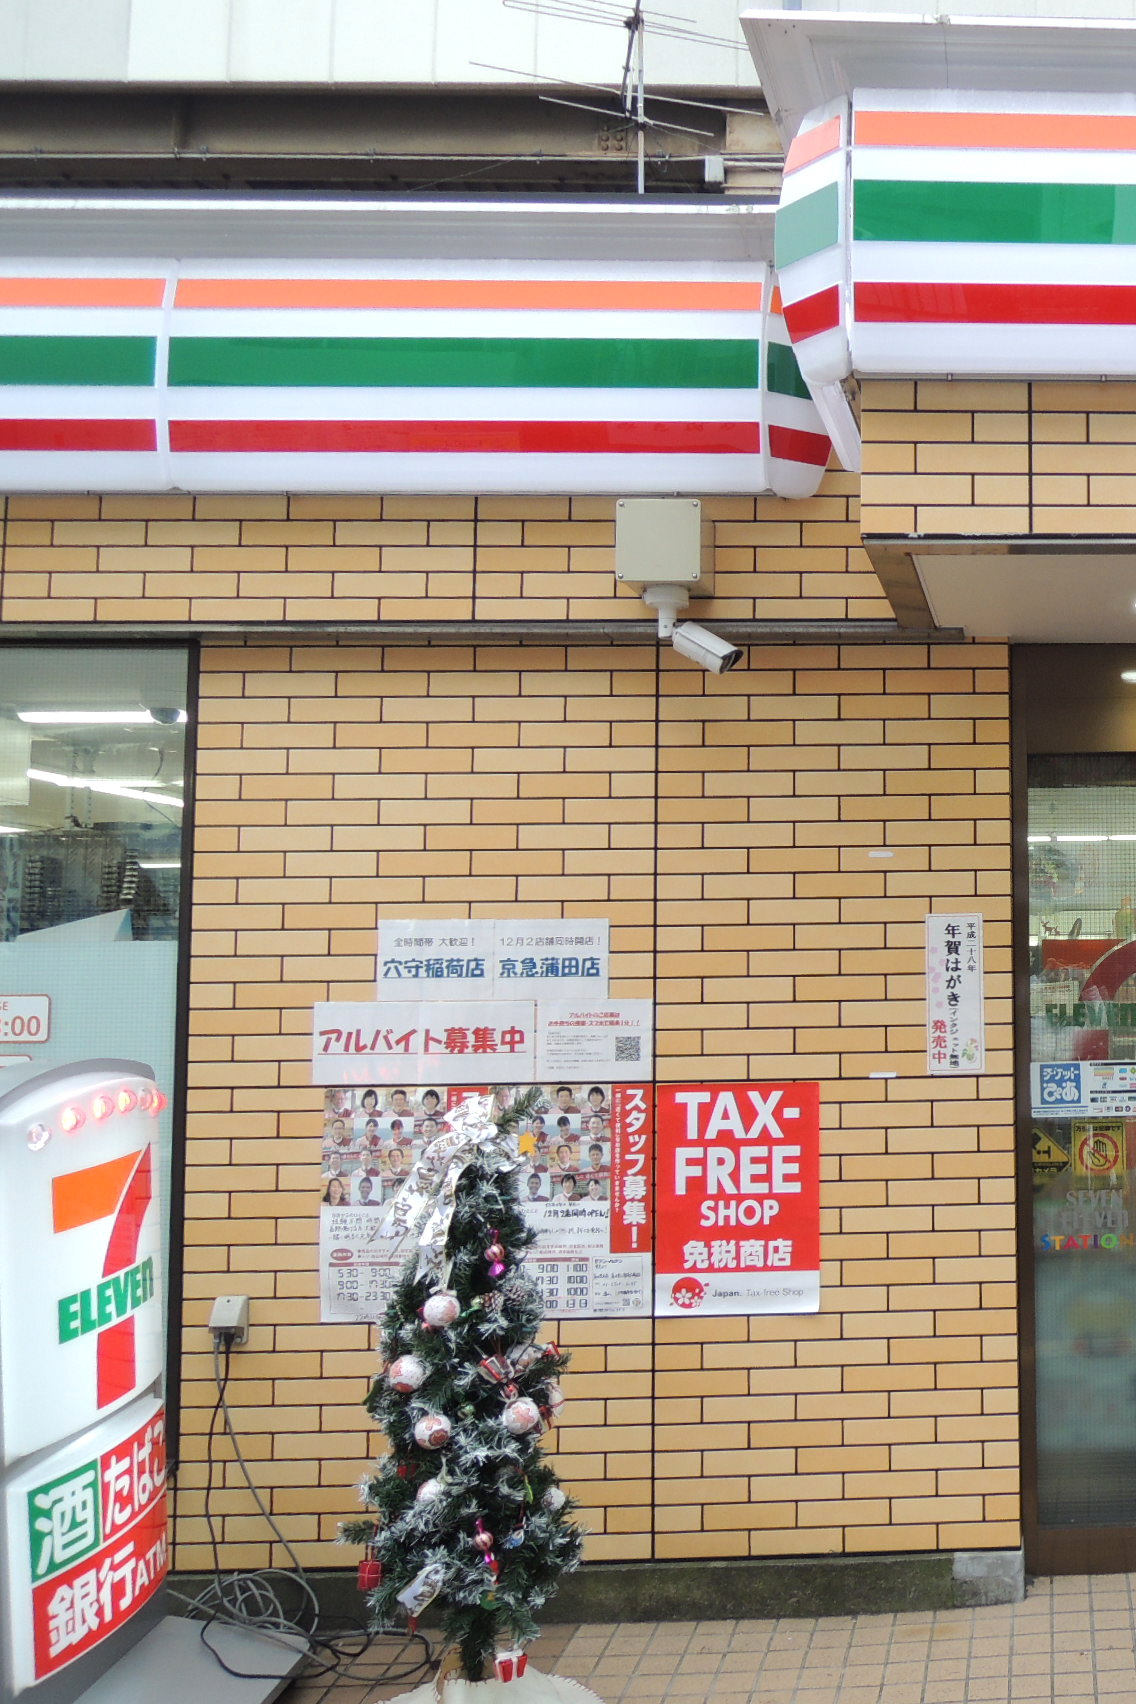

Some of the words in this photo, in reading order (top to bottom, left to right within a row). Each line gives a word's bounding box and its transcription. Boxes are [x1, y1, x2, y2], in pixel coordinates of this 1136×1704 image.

[966, 922, 977, 973] 平成二十八年
[383, 957, 486, 978] 穴守稲荷店
[499, 956, 601, 977] 京急蒲田店
[944, 923, 962, 1007] 年賀はがき
[0, 1015, 42, 1037] :00
[318, 1024, 526, 1053] アルバイト募集中
[931, 1019, 948, 1065] 発売中
[1043, 1067, 1080, 1080] チケット
[1043, 1081, 1080, 1102] ぴあ
[674, 1090, 801, 1140] TAX-
[622, 1088, 648, 1249] スタッフ募集!
[674, 1145, 802, 1195] FREE
[700, 1199, 780, 1227] SHOP
[1065, 1190, 1123, 1209] SEVEN
[682, 1238, 793, 1269] 免税商店
[1041, 1232, 1136, 1251] STATION
[712, 1288, 742, 1299] Japan.
[746, 1288, 780, 1298] Tax-free
[782, 1287, 804, 1299] Shop
[103, 1420, 168, 1535] たばこ
[33, 1469, 96, 1575] 酒
